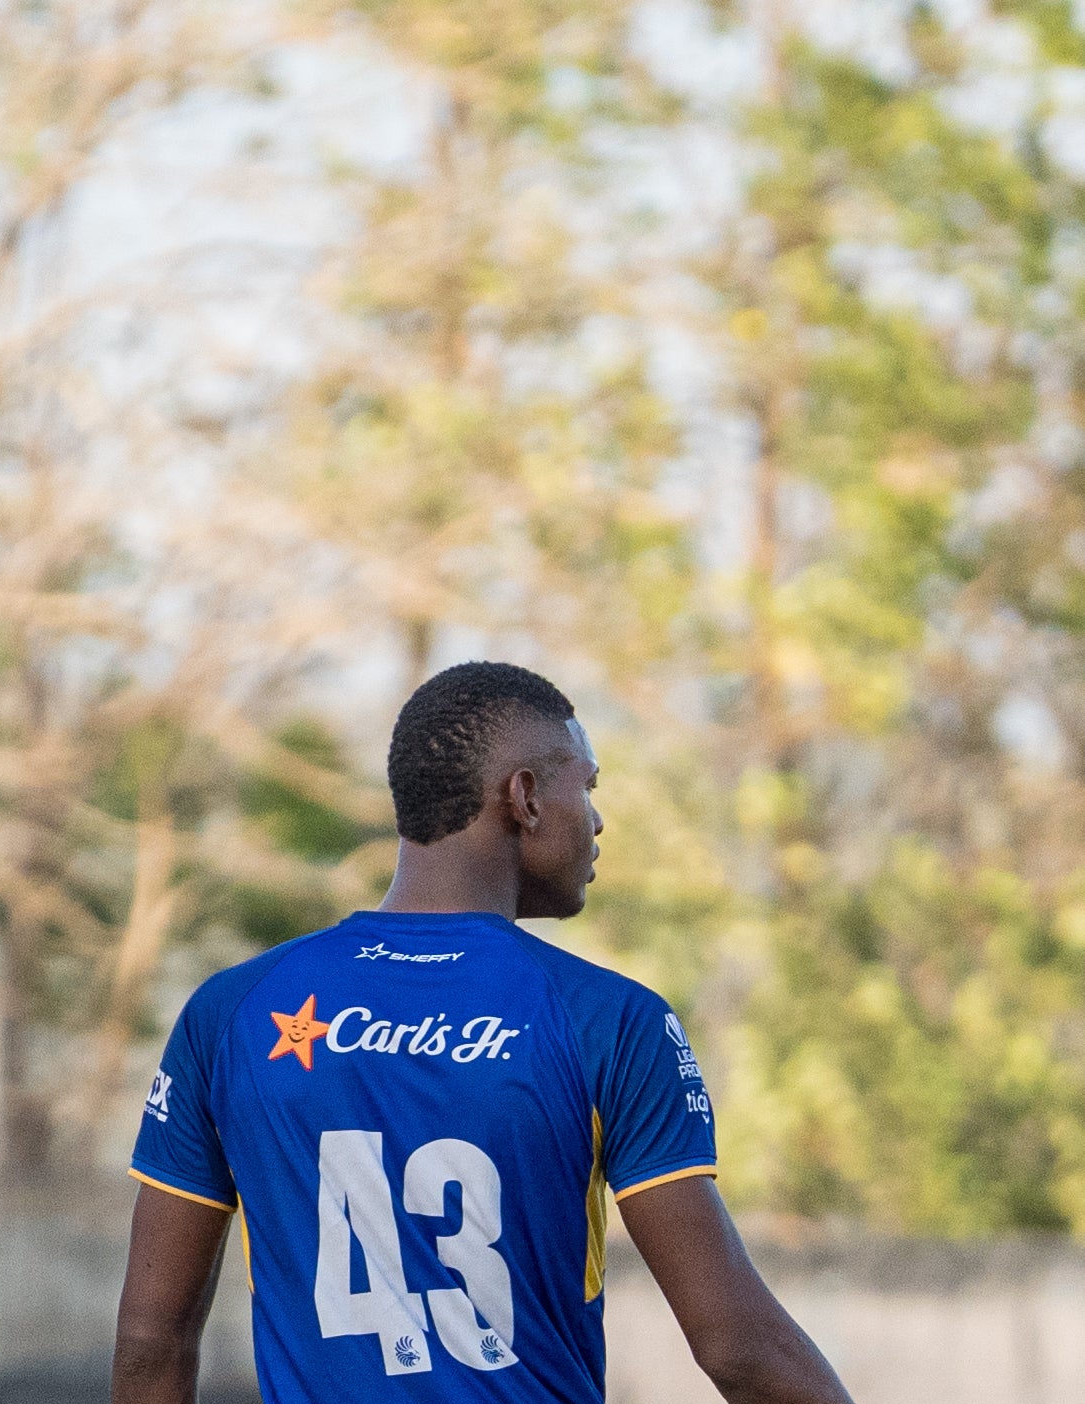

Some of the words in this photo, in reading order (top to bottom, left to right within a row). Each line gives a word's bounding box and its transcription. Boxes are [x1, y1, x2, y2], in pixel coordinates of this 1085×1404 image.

[388, 951, 465, 963] SHEFFY
[326, 1006, 453, 1056] Carl's
[451, 1016, 520, 1063] Jr.
[314, 1130, 519, 1376] 43
